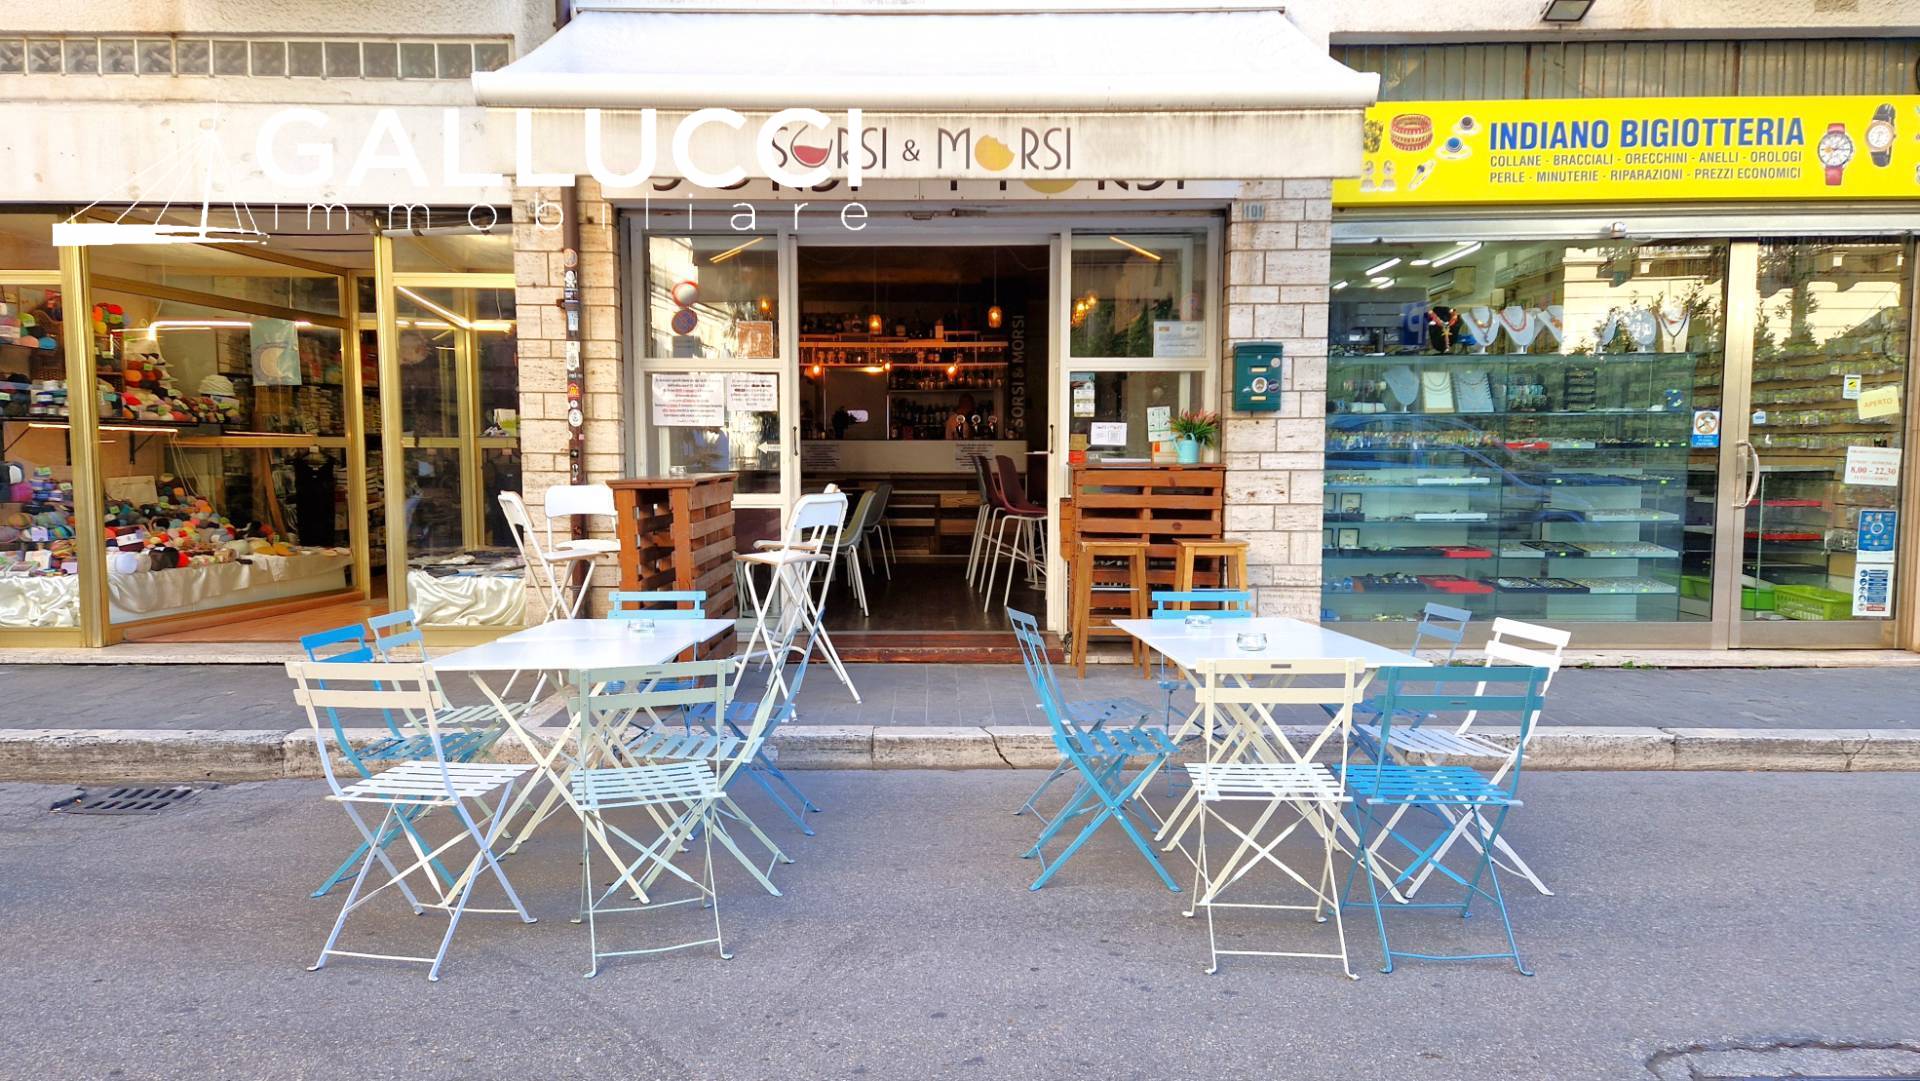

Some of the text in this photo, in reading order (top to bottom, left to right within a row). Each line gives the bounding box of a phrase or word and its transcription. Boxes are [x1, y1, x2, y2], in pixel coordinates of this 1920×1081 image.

[902, 139, 921, 162] &
[938, 127, 1071, 171] MORSI
[1490, 118, 1804, 150] INDIANO BIGIOTTERIA
[1490, 155, 1541, 167] COLLANE
[1553, 153, 1613, 166] BRACCIALI
[1625, 152, 1687, 165] ORECCHINI
[1699, 152, 1738, 163] ANELLI
[1750, 151, 1801, 162] OROLOGI
[1490, 171, 1525, 183] PERLE
[1536, 170, 1598, 182] MINUTERIE
[1611, 168, 1682, 181] RIPARAZIONI
[1695, 168, 1733, 179] PREZZI
[1738, 167, 1801, 179] ECONOMICI
[1246, 205, 1263, 217] 101
[1011, 315, 1025, 363] MORSI
[1011, 382, 1025, 431] SORSI
